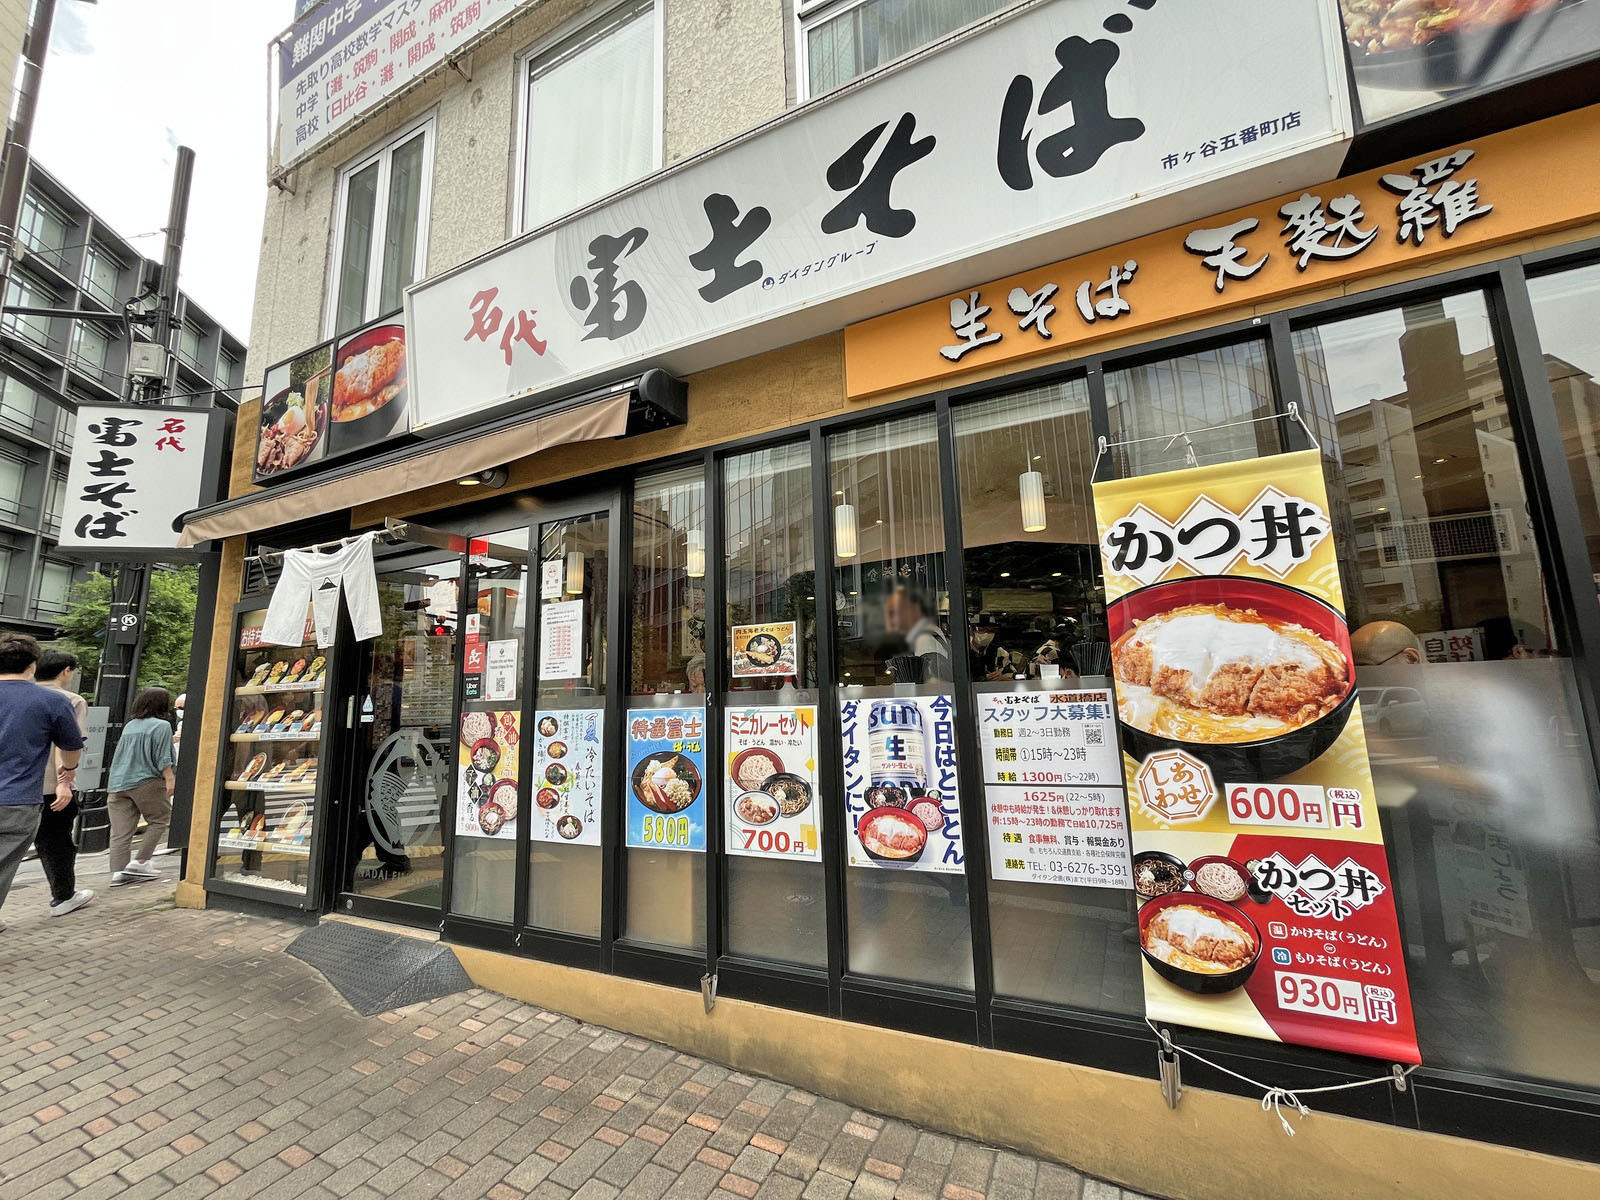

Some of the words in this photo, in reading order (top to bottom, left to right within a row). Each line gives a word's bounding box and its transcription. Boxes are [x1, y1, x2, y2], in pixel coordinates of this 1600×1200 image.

[778, 240, 879, 285] ダイタングループ
[939, 258, 1140, 363] 生そば
[155, 417, 187, 452] 名代
[1106, 501, 1322, 572] かつ丼
[1049, 692, 1108, 704] 水道橋店
[631, 716, 703, 740] 特選富士
[730, 713, 809, 736] ミニカレーセット
[885, 734, 906, 760] 生
[995, 747, 1017, 762] 時間帯
[584, 746, 598, 824] 冷たいそば
[929, 695, 965, 866] 今日はとことん
[1022, 771, 1063, 783] 1300円
[1023, 791, 1065, 802] 1625円
[1230, 786, 1324, 824] 600円
[1332, 802, 1364, 829] 円
[643, 815, 689, 845] 580円
[742, 828, 805, 854] 700円
[1004, 858, 1026, 871] 連絡先
[1049, 860, 1129, 877] 03-6276-3591
[1257, 859, 1380, 903] かつ丼
[1288, 894, 1350, 919] セット
[1279, 975, 1360, 1016] 930円
[1369, 997, 1396, 1022] 円
